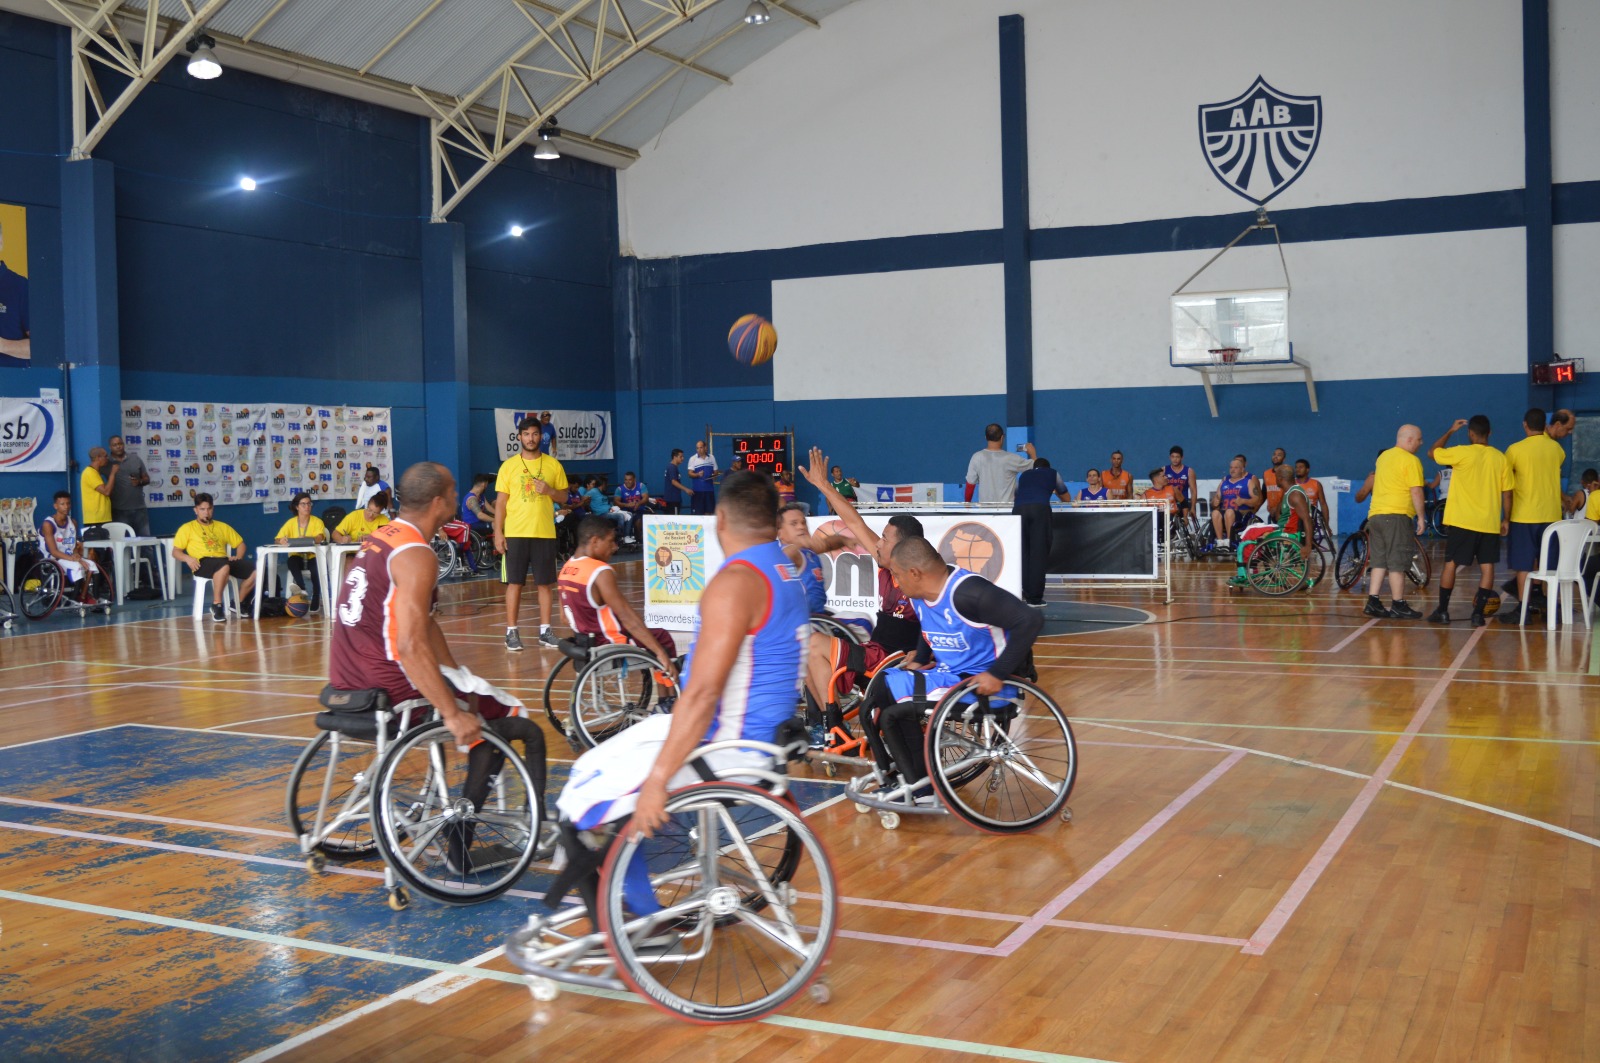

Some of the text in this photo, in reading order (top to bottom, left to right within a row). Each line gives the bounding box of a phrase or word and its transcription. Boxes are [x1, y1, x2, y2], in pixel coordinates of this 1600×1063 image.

[1230, 98, 1291, 127] AAB
[1557, 366, 1572, 381] 14
[0, 415, 29, 439] sb
[558, 423, 596, 438] sudesb
[506, 443, 520, 452] DO
[740, 442, 746, 451] 0
[774, 440, 780, 449] 0
[747, 453, 773, 463] 00:00
[776, 463, 782, 472] 0
[339, 566, 368, 627] 3
[828, 598, 874, 608] nordeste
[932, 636, 960, 648] SESI
